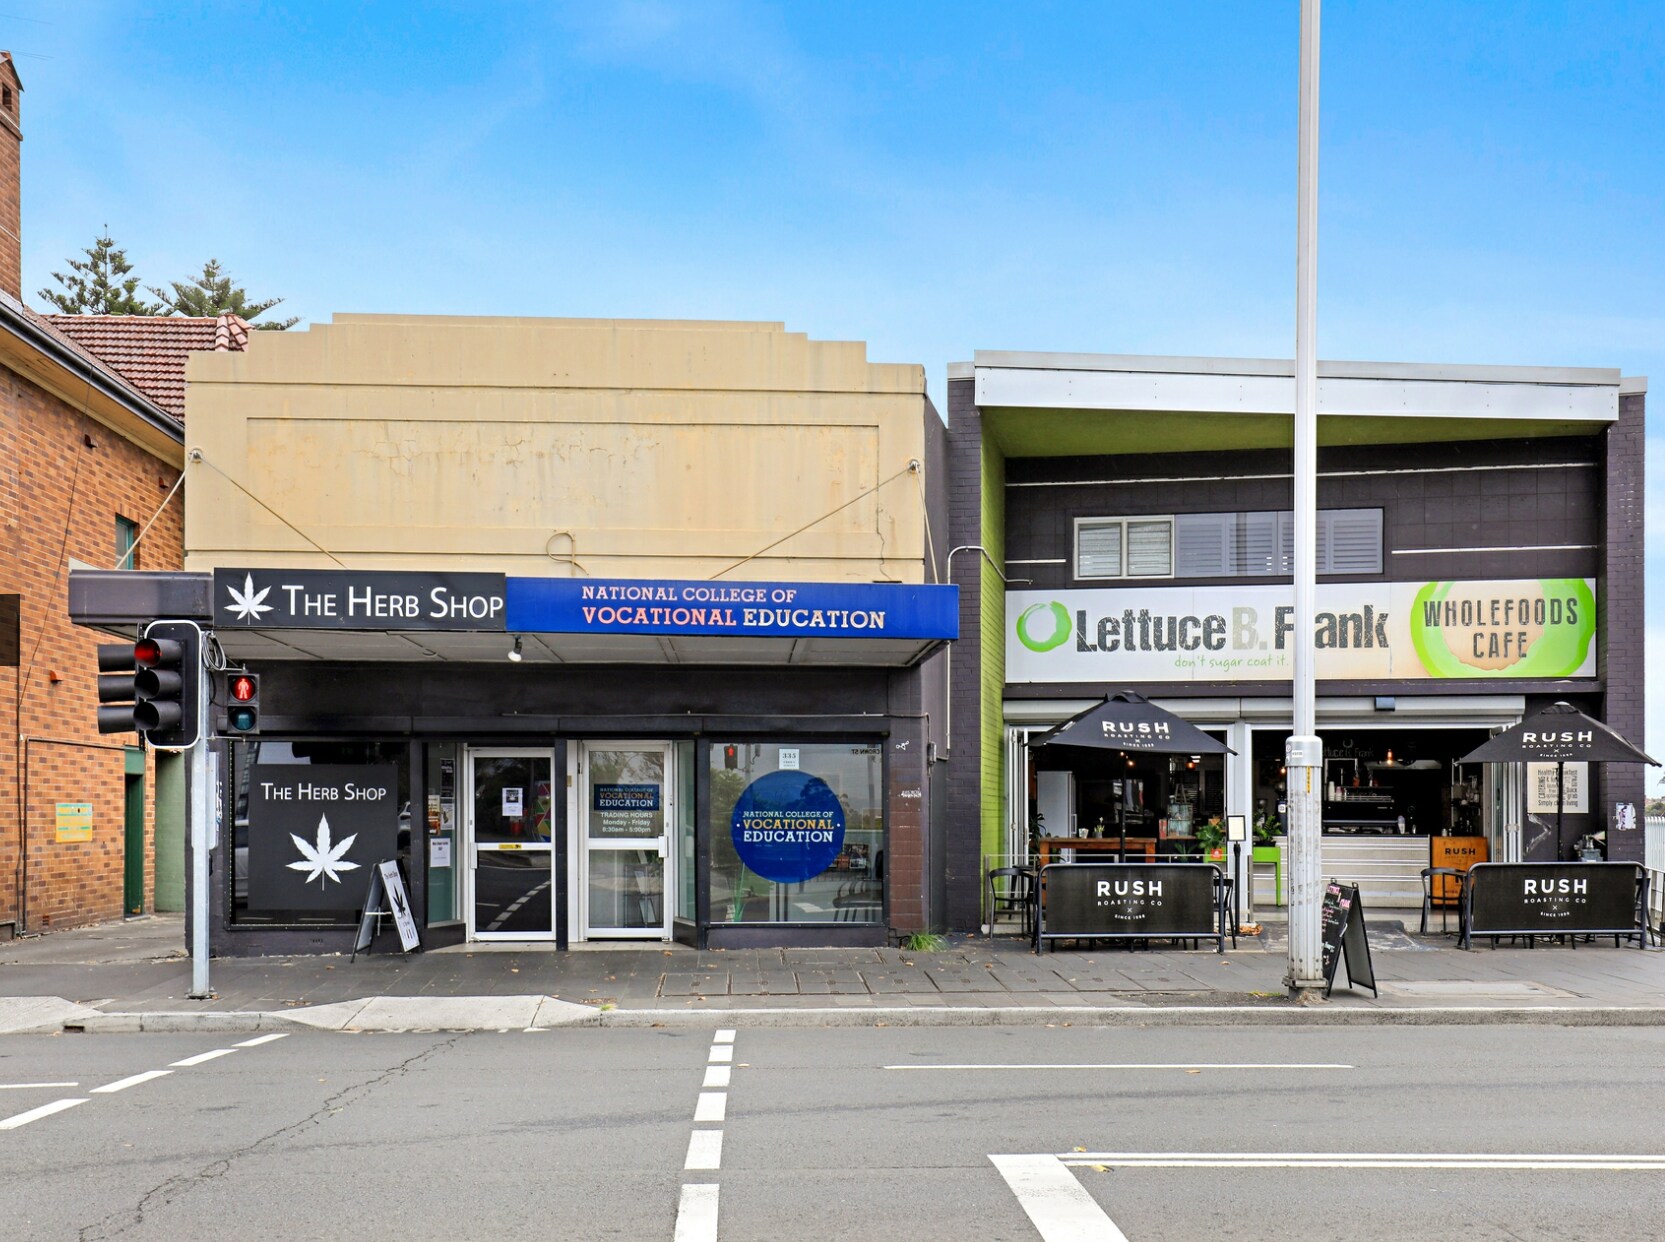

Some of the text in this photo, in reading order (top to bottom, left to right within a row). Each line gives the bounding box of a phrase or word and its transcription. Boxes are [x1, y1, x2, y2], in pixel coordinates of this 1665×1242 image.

[582, 586, 797, 603] NATIONAL COLLEGE OF
[582, 606, 886, 629] VOCATIONAL EDUCATION
[1423, 597, 1579, 627] WHOLEFOODS
[1076, 608, 1226, 652] Lettuce
[1274, 604, 1390, 650] Fank
[1472, 631, 1528, 658] CAFE
[1174, 655, 1207, 669] don't
[1208, 656, 1243, 673] sugar
[1247, 655, 1273, 668] coat
[1101, 720, 1170, 734] RUSH
[1522, 730, 1593, 743] RUSH
[742, 810, 783, 818] NATIONAL
[785, 810, 821, 818] COLLEGE
[631, 819, 651, 827] Friday
[743, 819, 835, 830] VOCATIONAL
[743, 830, 834, 843] EDUCATION
[1444, 847, 1476, 855] RUSH
[1097, 880, 1163, 897] RUSH
[1524, 879, 1587, 895] RUSH
